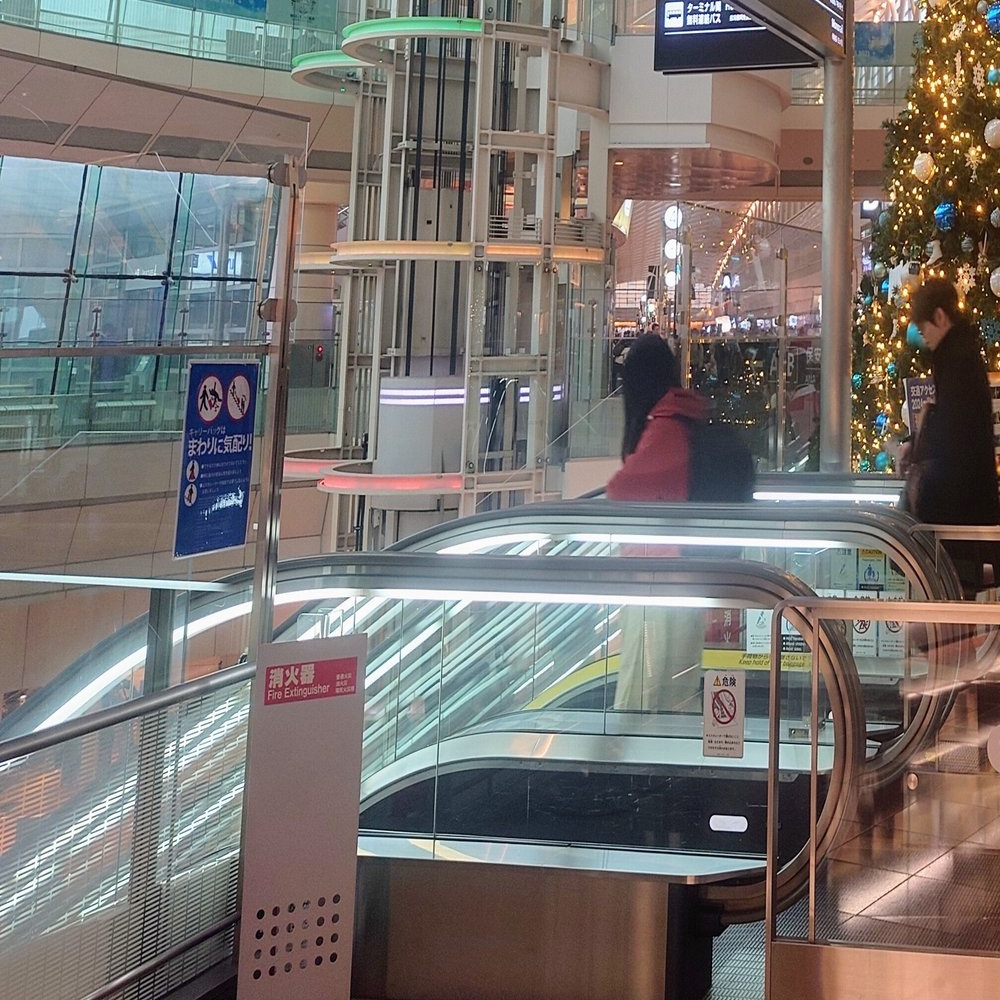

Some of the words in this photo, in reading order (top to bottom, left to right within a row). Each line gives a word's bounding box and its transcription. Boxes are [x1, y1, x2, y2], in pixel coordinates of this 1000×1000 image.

[686, 1, 722, 14] ターミナル間
[269, 663, 315, 689] 消火器
[722, 676, 737, 687] 危険
[267, 689, 282, 700] Fire
[284, 684, 330, 699] Extinguisher
